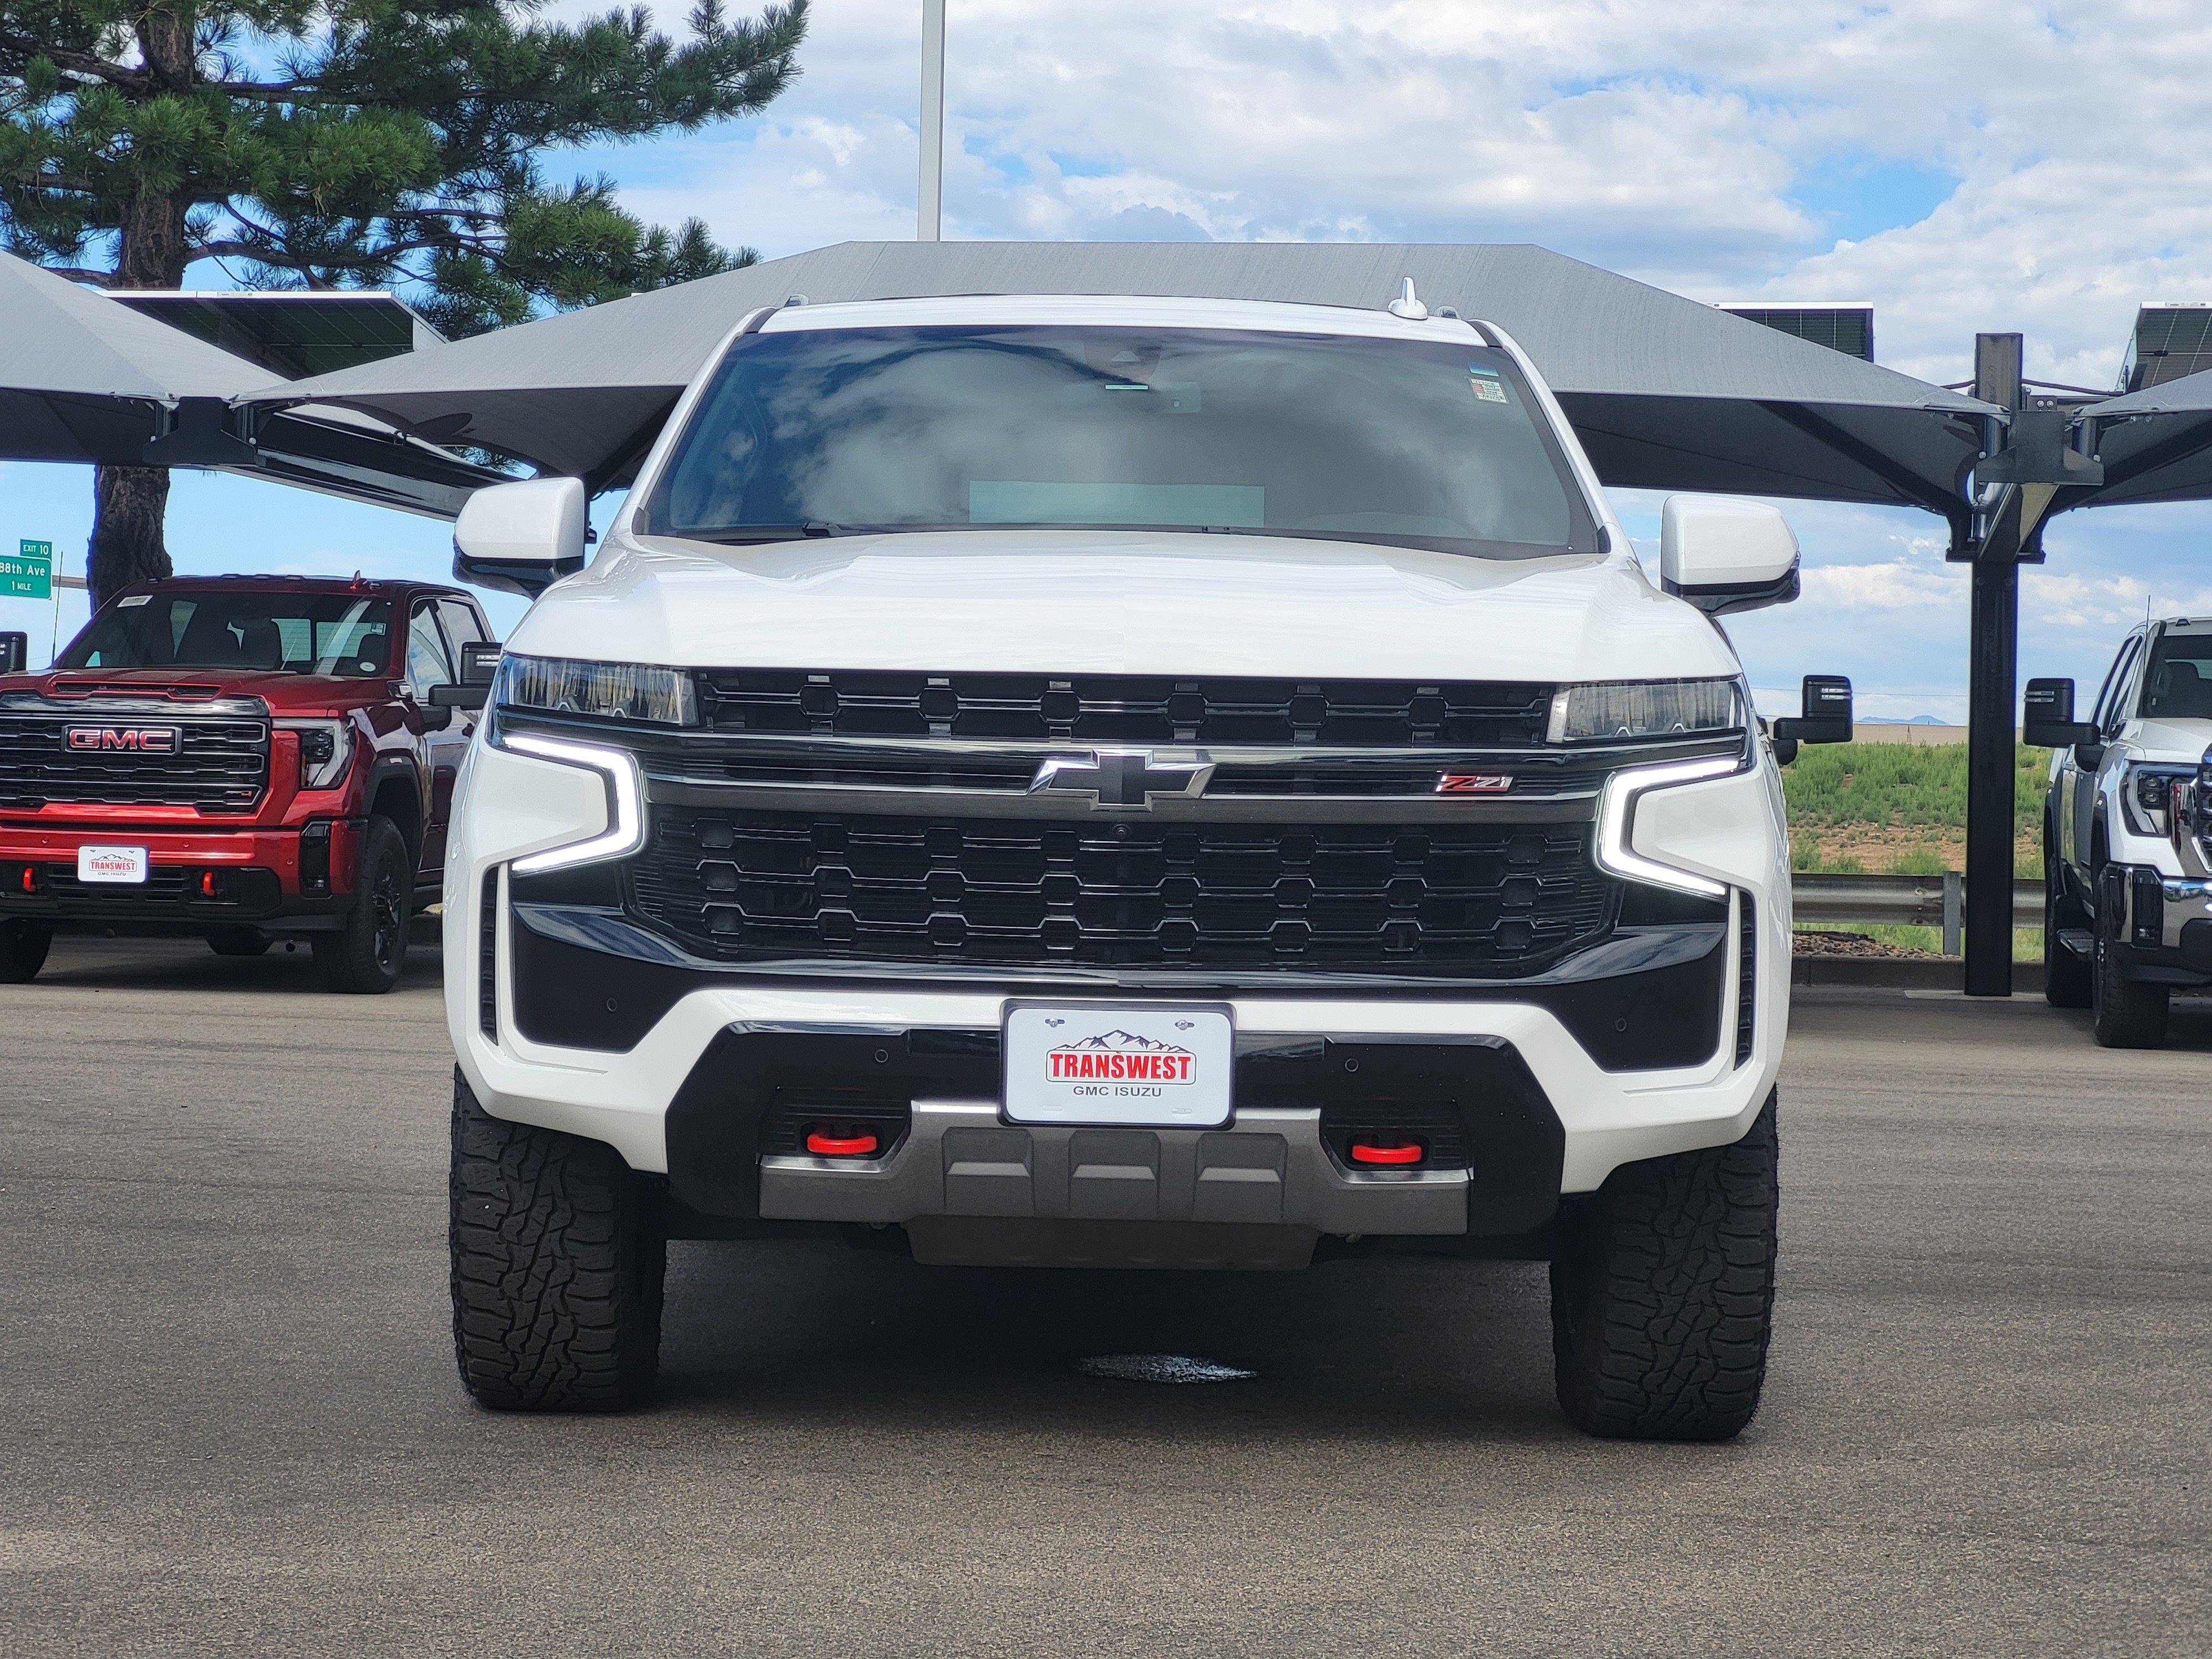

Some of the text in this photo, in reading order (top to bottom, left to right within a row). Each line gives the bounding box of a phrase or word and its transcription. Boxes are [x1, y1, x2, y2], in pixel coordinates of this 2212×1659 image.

[40, 545, 49, 555] 10
[0, 562, 45, 576] 88th Ave
[12, 581, 32, 591] 1 MILE
[69, 729, 172, 751] GMC
[1436, 775, 1514, 792] Z71
[91, 862, 135, 870] TRANSWEST
[1050, 1053, 1191, 1079] TRANSWEST
[1073, 1086, 1161, 1097] GMC ISUZU
